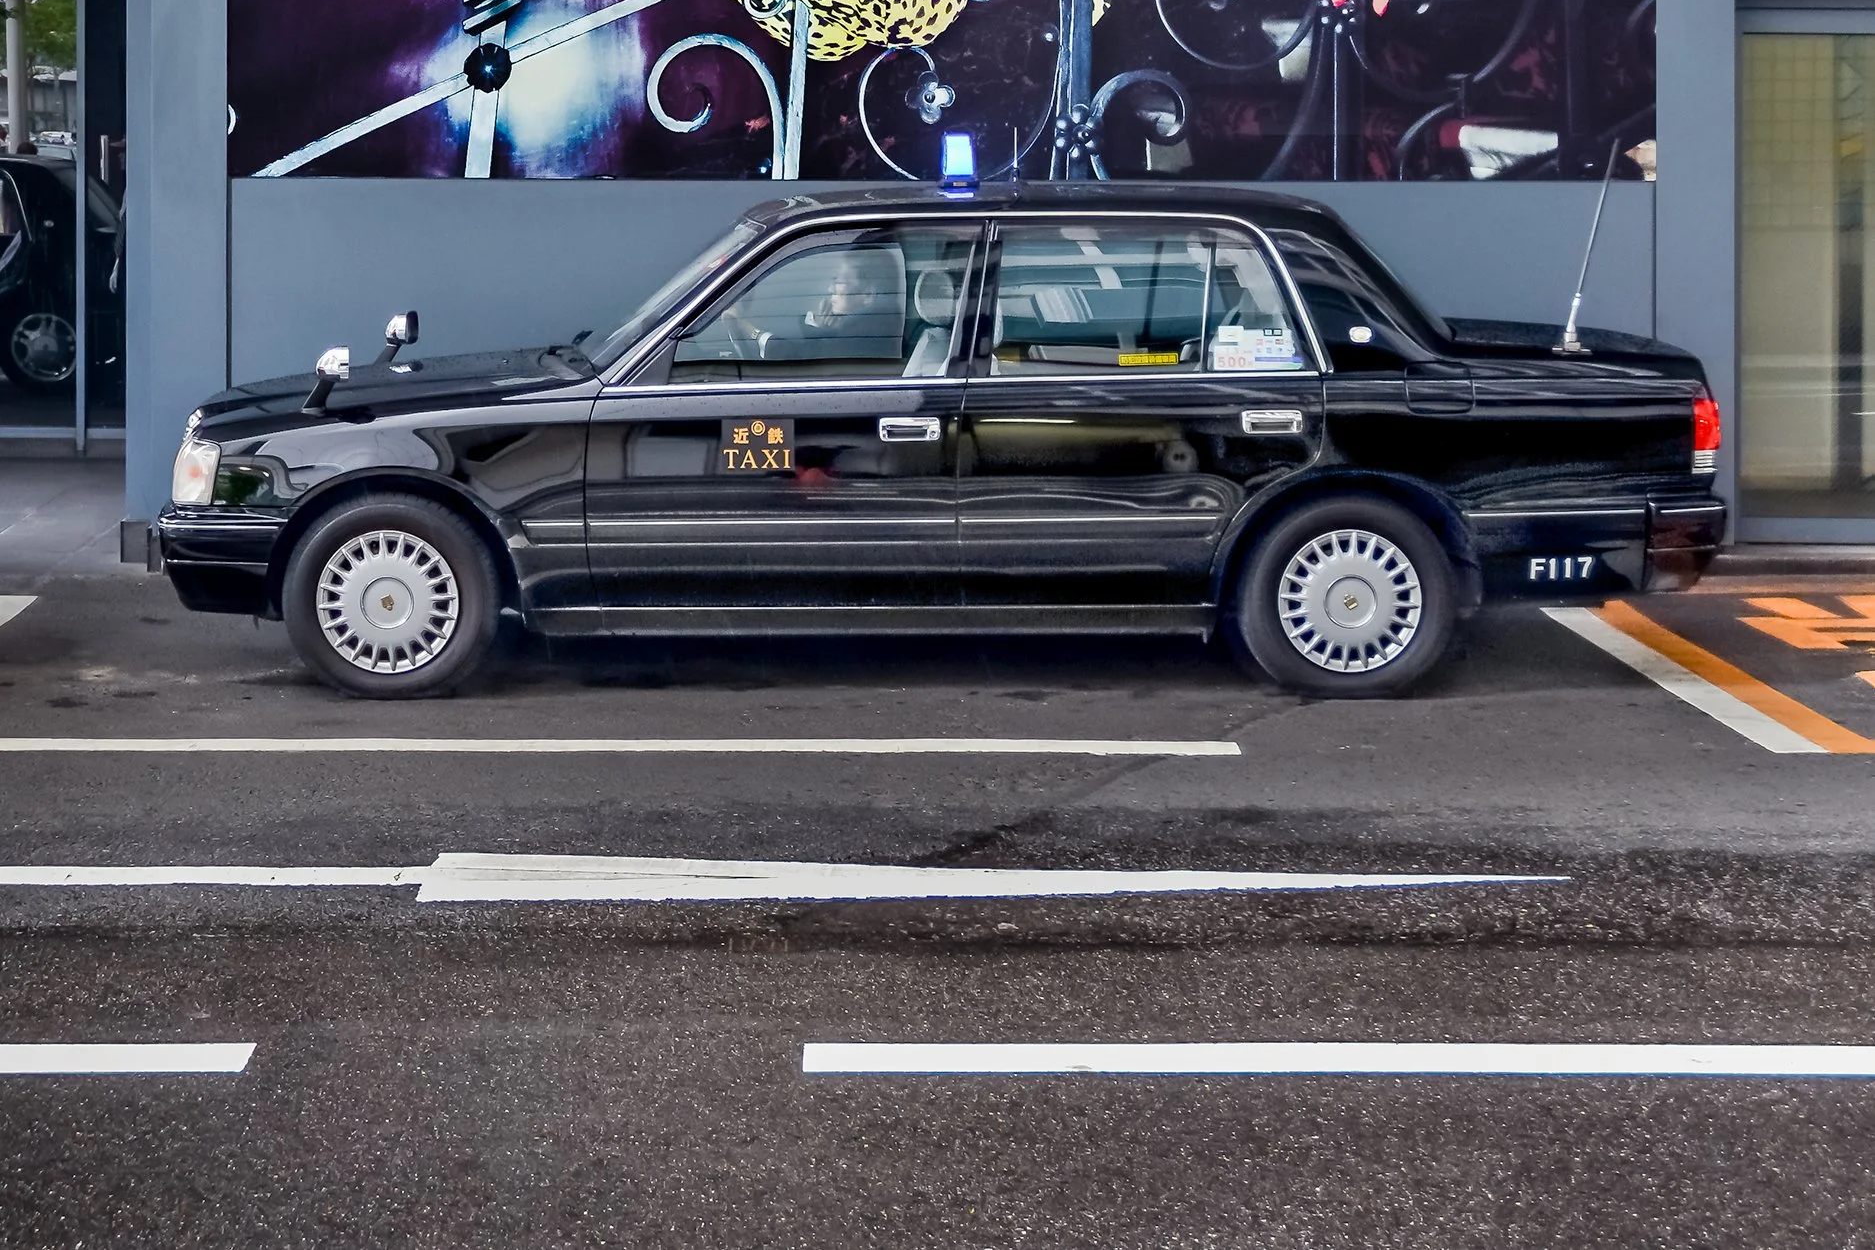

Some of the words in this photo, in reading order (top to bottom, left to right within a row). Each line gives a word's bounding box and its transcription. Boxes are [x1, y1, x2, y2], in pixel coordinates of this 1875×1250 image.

[1218, 356, 1246, 368] 500
[723, 449, 791, 469] TAXI
[1529, 556, 1594, 580] F117
